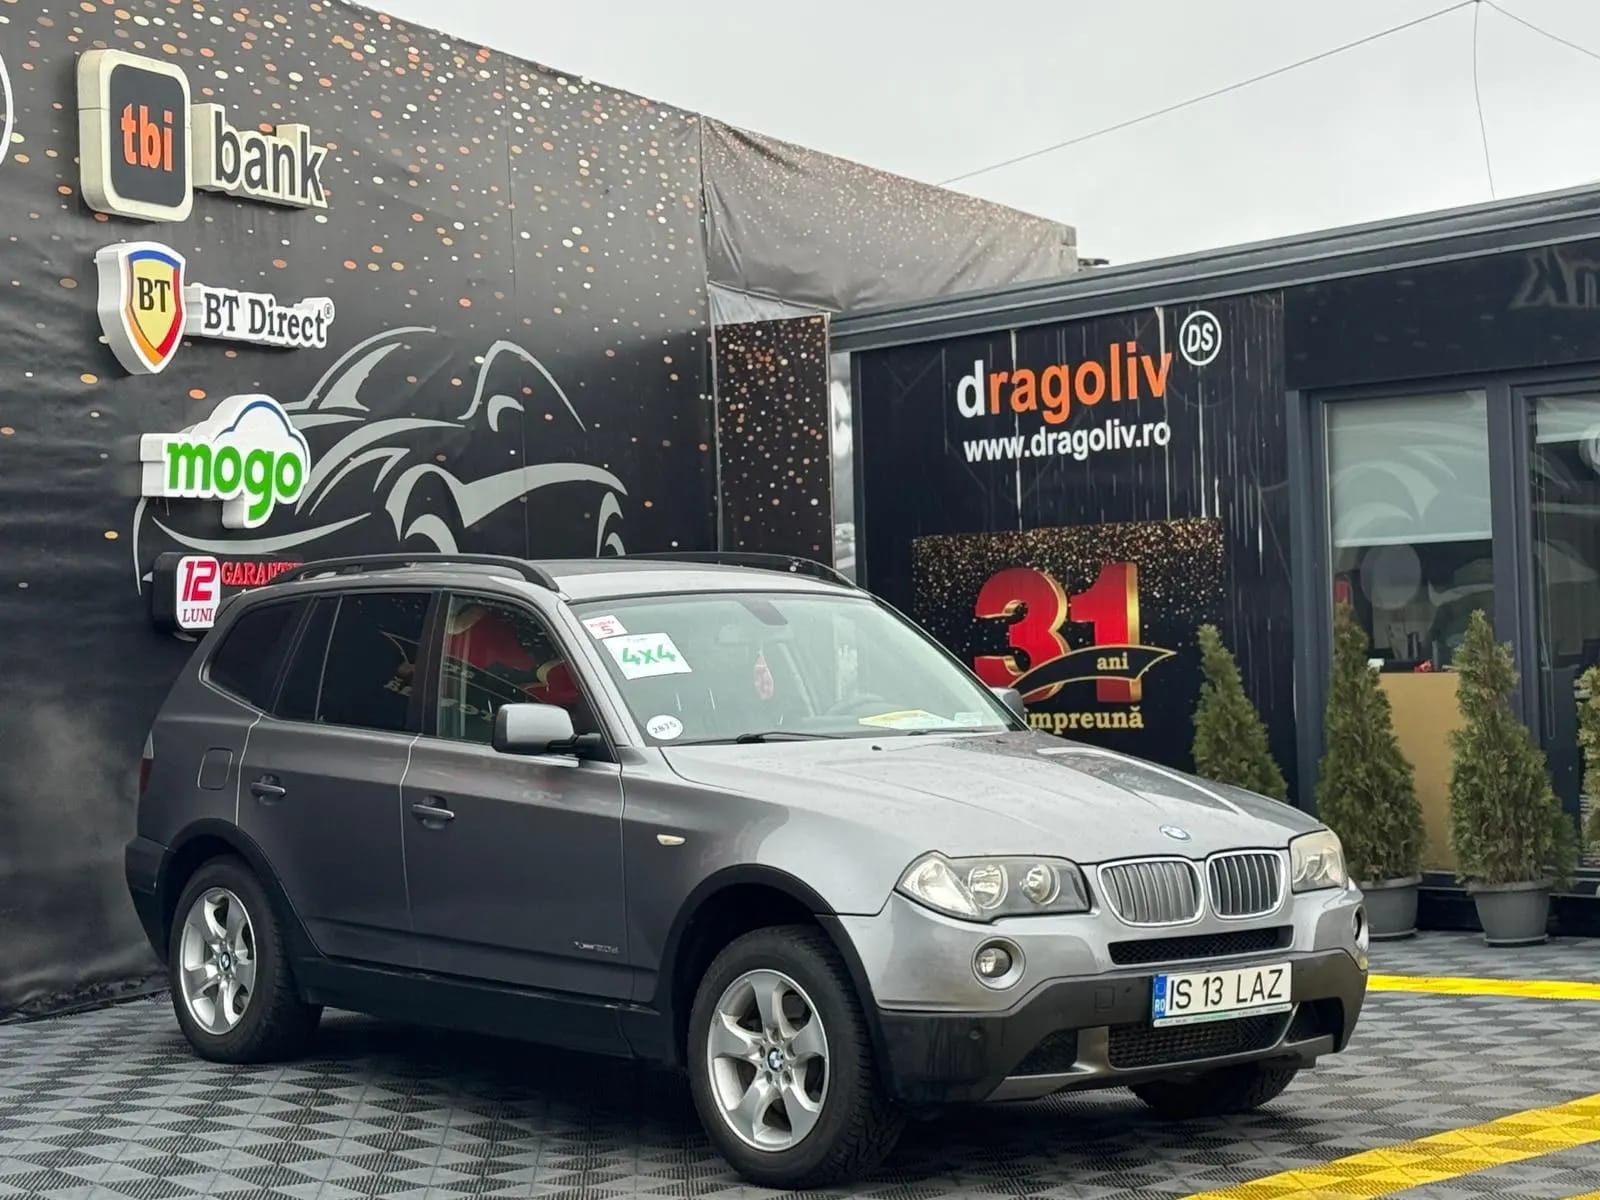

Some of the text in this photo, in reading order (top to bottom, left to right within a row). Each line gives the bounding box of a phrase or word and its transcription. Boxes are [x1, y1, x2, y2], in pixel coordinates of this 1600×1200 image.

[121, 104, 327, 205] tbi bank
[137, 277, 171, 313] BT
[204, 292, 239, 332] BT
[1186, 322, 1214, 353] DS
[956, 341, 1172, 424] dragoliv
[963, 419, 1171, 460] www.dragoliv.ro
[167, 442, 303, 521] mogo
[182, 560, 217, 602] 12
[182, 608, 214, 623] LUNI
[974, 562, 1142, 704] 31
[1097, 652, 1129, 670] ani
[1169, 968, 1284, 1011] IS 13 LAZ
